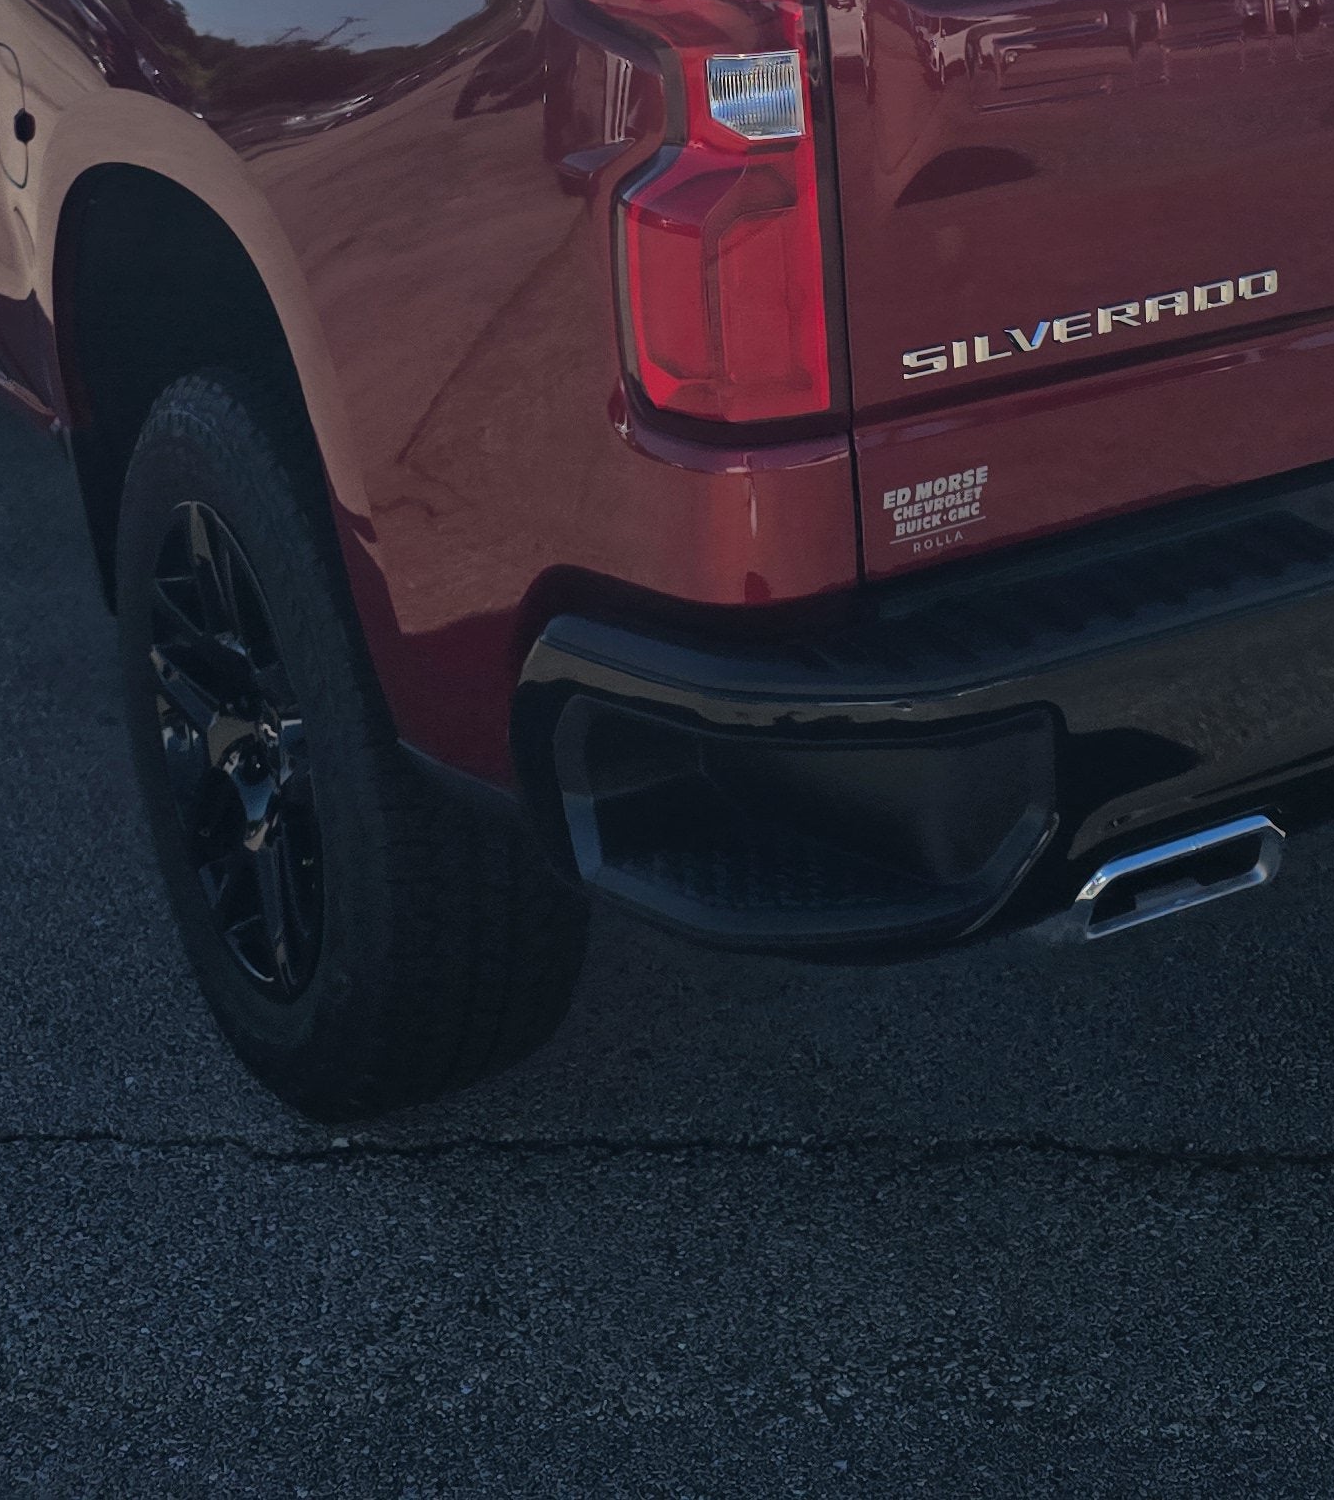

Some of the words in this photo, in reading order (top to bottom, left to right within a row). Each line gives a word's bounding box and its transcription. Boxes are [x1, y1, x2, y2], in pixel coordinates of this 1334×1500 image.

[902, 269, 1278, 380] SILVERADO
[883, 487, 912, 510] ED
[915, 465, 988, 502] MORSE
[893, 485, 983, 522] CHEVROLET
[913, 530, 964, 553] ROLLA
